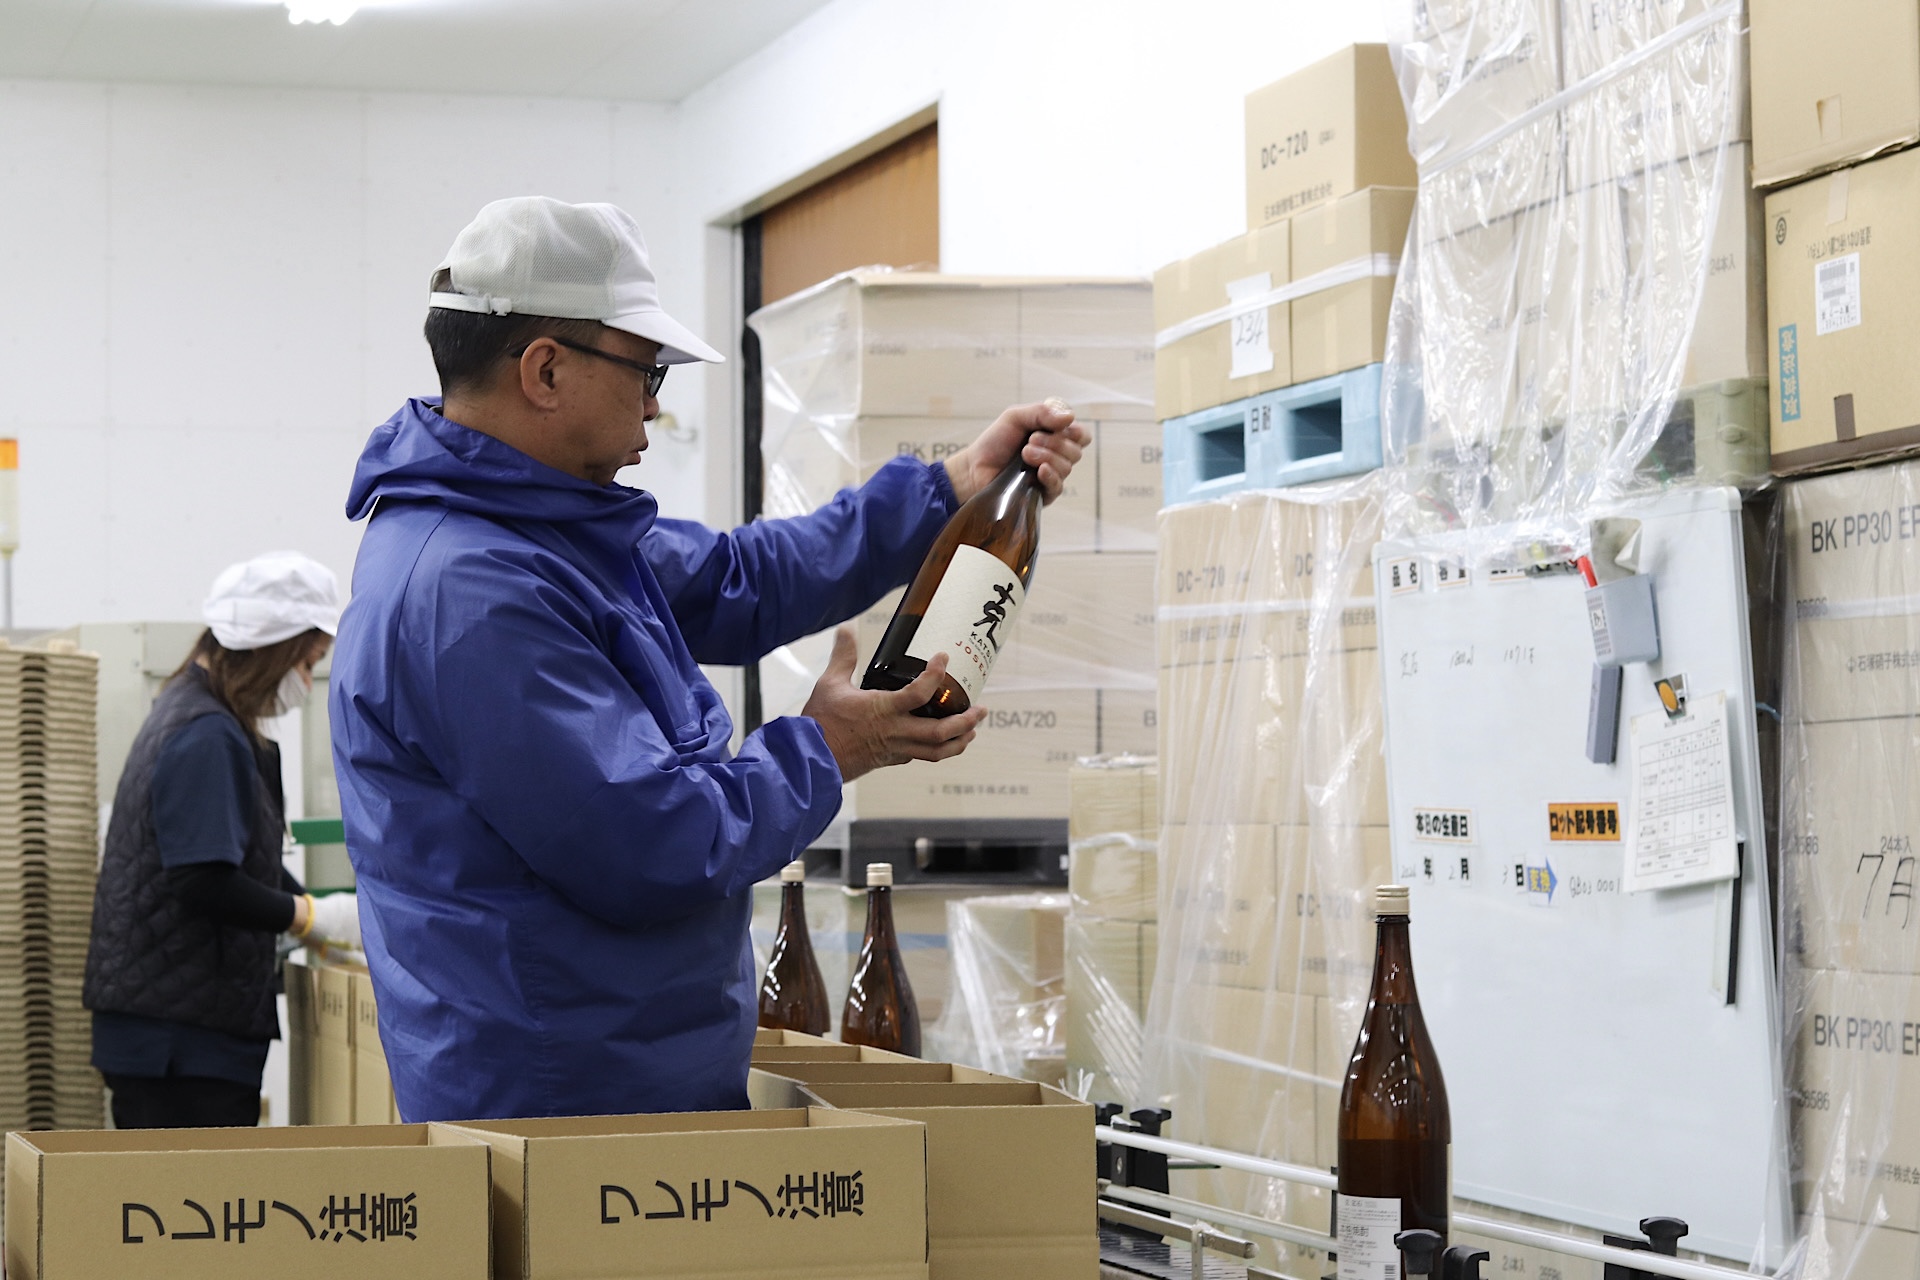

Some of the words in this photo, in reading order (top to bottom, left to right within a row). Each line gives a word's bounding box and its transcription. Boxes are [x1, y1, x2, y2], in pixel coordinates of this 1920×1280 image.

[1260, 129, 1309, 171] DC-720
[932, 442, 969, 460] PP
[1811, 518, 1839, 553] BK
[1843, 509, 1892, 549] PP30
[1549, 809, 1618, 835] ロット記号番号
[1880, 835, 1912, 855] 24本入
[1460, 858, 1470, 881] 月
[1515, 864, 1525, 887] 日
[1814, 1014, 1840, 1049] BK
[1846, 1017, 1895, 1054] PP30
[600, 1169, 864, 1224] ワレモノ注意
[122, 1191, 418, 1244] ワレモノ注意
